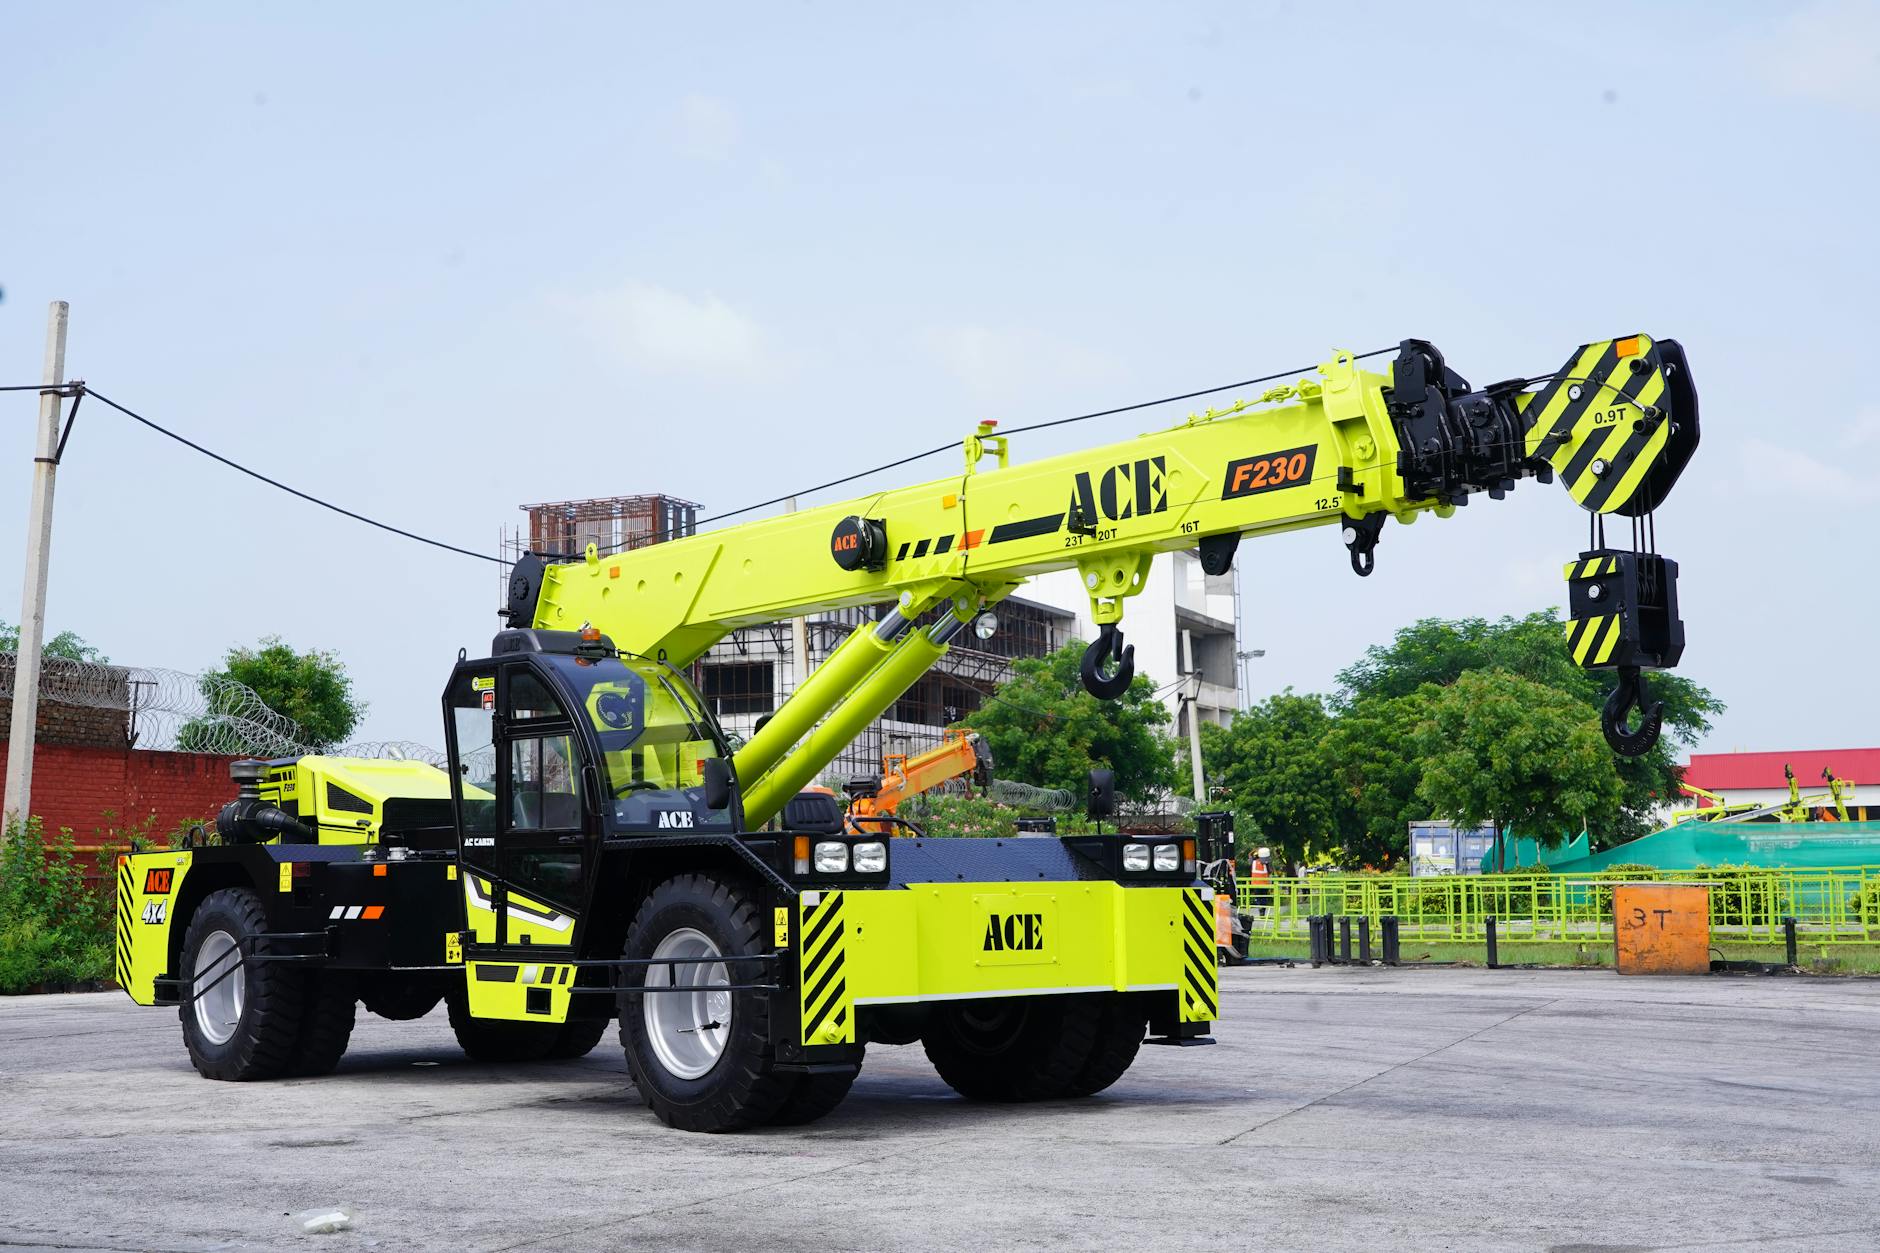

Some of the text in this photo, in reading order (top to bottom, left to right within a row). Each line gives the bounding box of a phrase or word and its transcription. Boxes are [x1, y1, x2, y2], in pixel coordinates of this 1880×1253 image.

[1594, 408, 1627, 424] 0.9T
[1231, 453, 1307, 492] F230
[1067, 455, 1168, 531] ACE
[1315, 496, 1343, 510] 12.5
[1098, 528, 1118, 541] 20T
[1181, 520, 1200, 534] 16T
[834, 533, 858, 552] ACE
[1065, 535, 1084, 548] 23T
[658, 811, 694, 829] ACE
[464, 838, 495, 847] AC CABIN
[146, 870, 170, 892] ACE
[983, 914, 1043, 951] ACE
